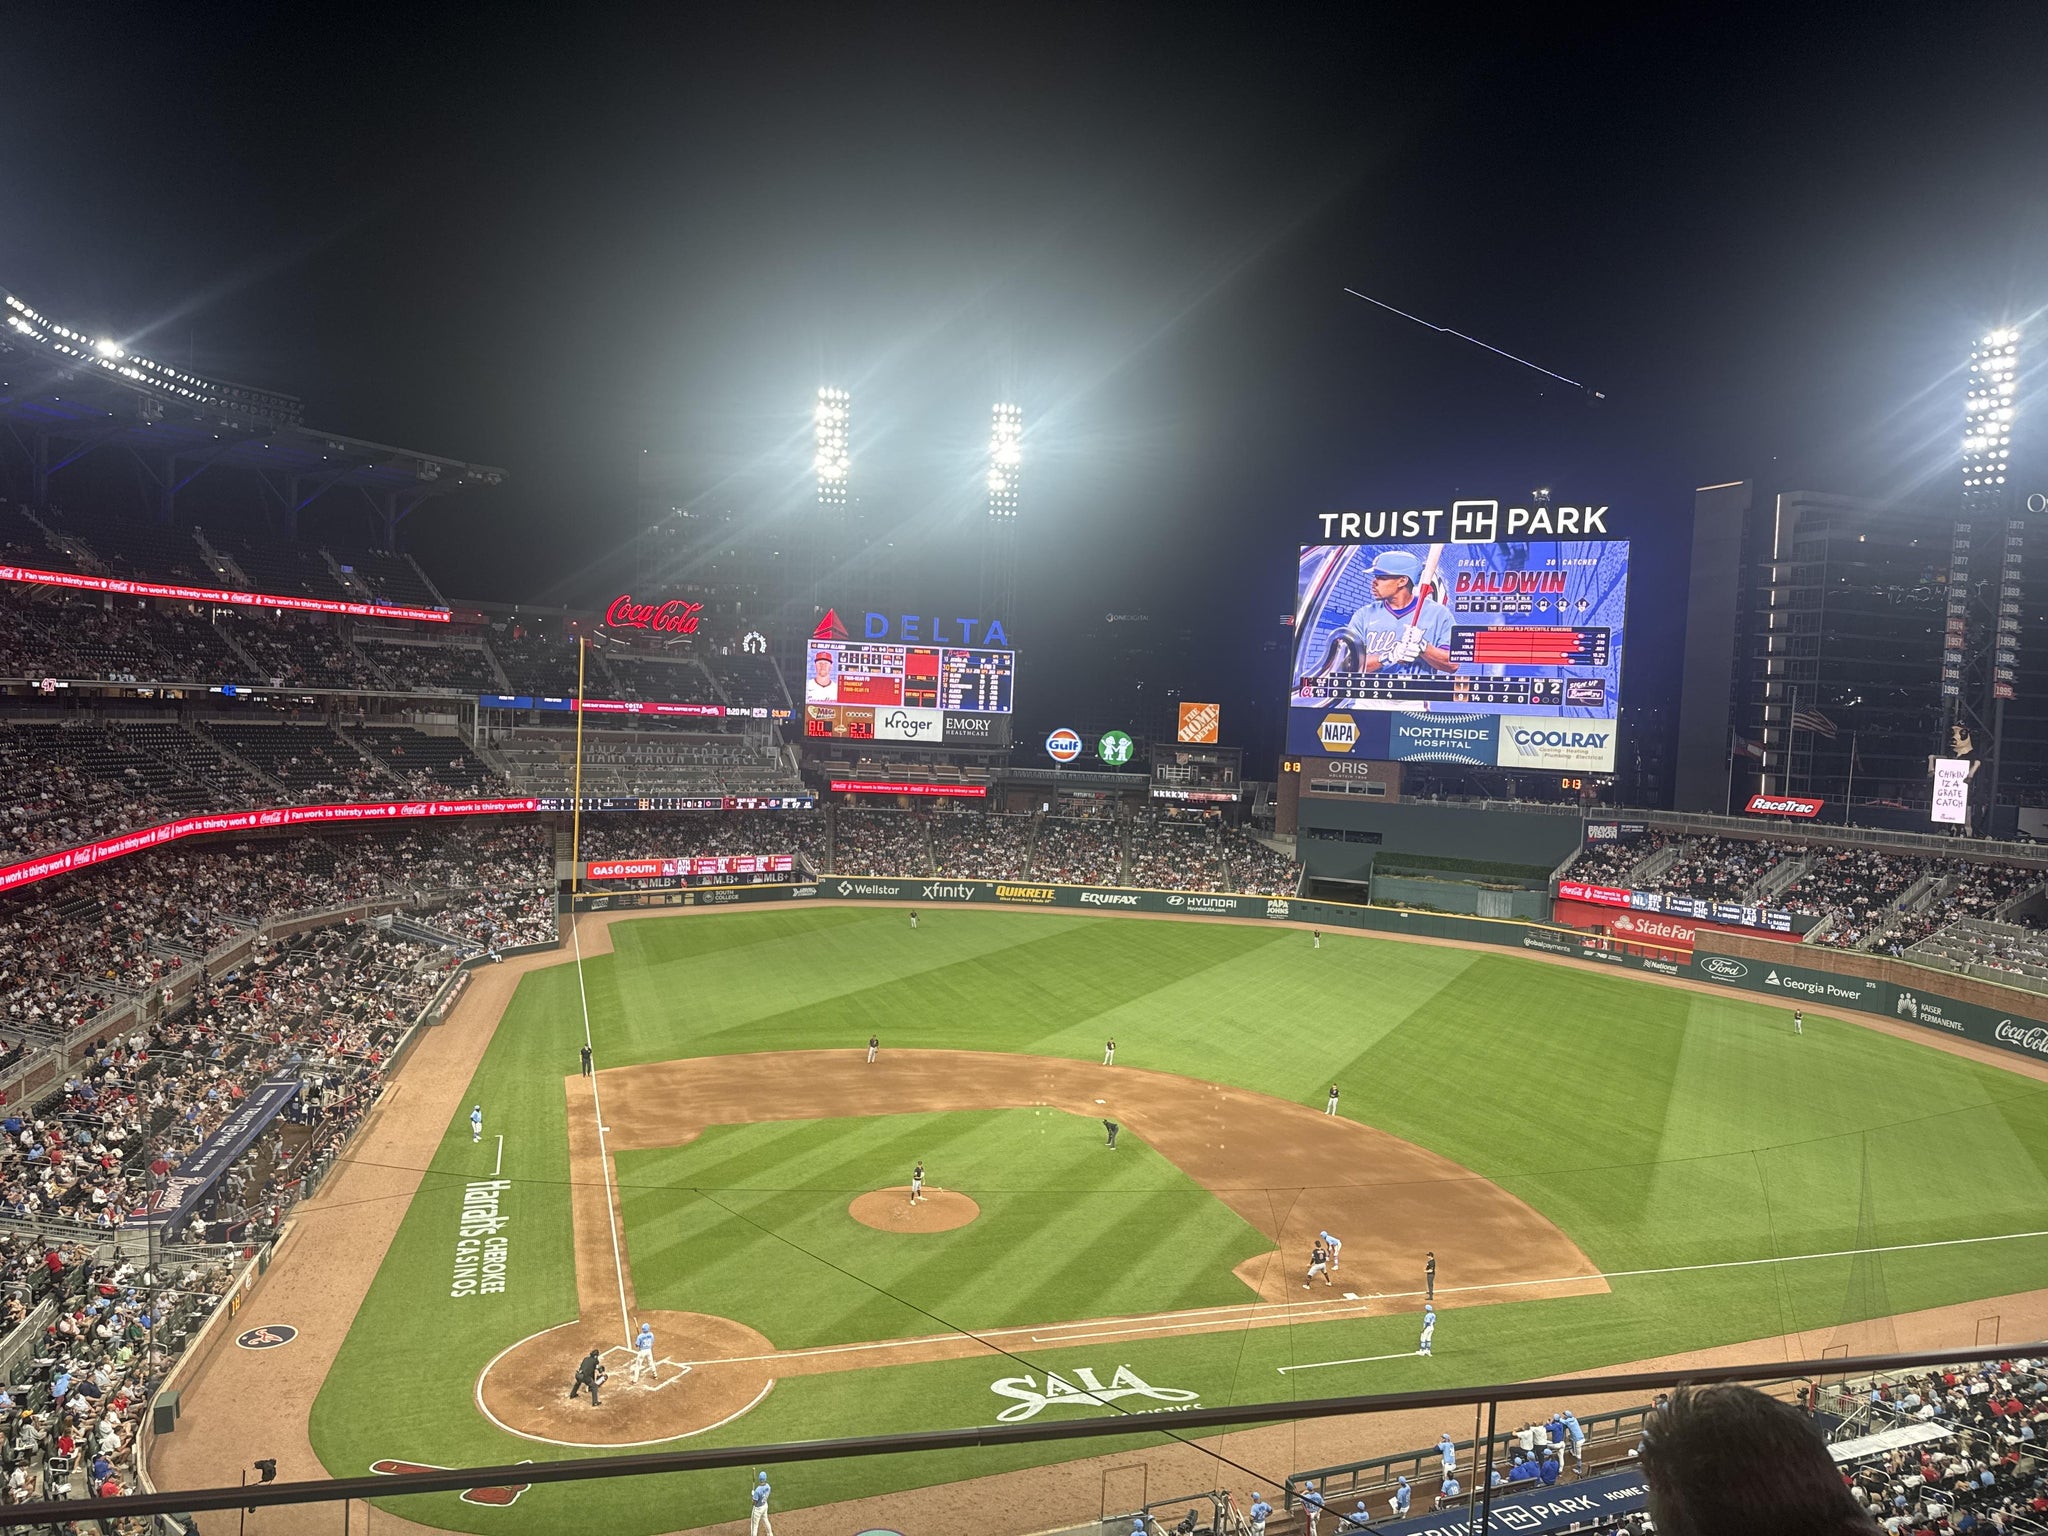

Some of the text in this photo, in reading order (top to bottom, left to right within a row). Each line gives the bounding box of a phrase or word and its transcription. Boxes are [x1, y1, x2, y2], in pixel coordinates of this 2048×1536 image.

[1319, 506, 1609, 539] TRUIST PARK
[1458, 559, 1486, 567] DRAKE
[1456, 570, 1568, 594] BALDWIN
[148, 587, 168, 595] work
[176, 589, 201, 598] thirsty
[606, 594, 704, 634] Coca-Cola
[1950, 604, 1966, 614] 1897
[864, 612, 1008, 646] DELTA
[1948, 638, 1962, 646] 1957
[1999, 654, 2014, 662] 1982
[1946, 670, 1960, 678] 1991
[1998, 670, 2013, 680] 1992
[41, 678, 57, 692] 47
[222, 684, 237, 696] 42
[1534, 683, 1544, 694] 0
[1550, 684, 1560, 694] 2
[1944, 686, 1959, 695] 1993
[1996, 686, 2012, 696] 1995
[740, 708, 750, 716] PM
[1184, 707, 1200, 723] THE
[808, 720, 824, 732] 80
[885, 711, 932, 738] Kroger
[946, 718, 992, 731] EMORY
[1180, 704, 1218, 741] HOME
[1194, 718, 1218, 742] DEPOT
[1324, 724, 1353, 742] NAPA
[1399, 726, 1489, 740] NORTHSIDE
[1048, 740, 1079, 750] Gulf
[1414, 740, 1472, 749] HOSPITAL
[1514, 730, 1610, 748] COOLRAY
[583, 745, 758, 765] HANK AARON TERRACE
[1284, 761, 1301, 773] 0:13
[1329, 762, 1368, 774] ORIS
[1938, 770, 1966, 778] CHIKIN
[1562, 778, 1582, 790] 0:13
[1942, 779, 1950, 788] IZ
[1938, 788, 1962, 798] GRATE
[401, 804, 427, 815] Coca-Cola
[482, 802, 506, 812] thirsty
[1752, 798, 1814, 814] RaceTrac
[1936, 798, 1964, 808] CATCH
[260, 812, 282, 825] Coca-Cola
[292, 812, 304, 820] Fan
[304, 810, 324, 818] work
[334, 808, 364, 818] thirsty
[364, 807, 386, 815] work
[1588, 826, 1618, 834] BRAVES
[593, 864, 657, 876] GAS SOUTH
[662, 864, 675, 872] AL
[649, 876, 676, 888] MLB+
[713, 875, 740, 885] MB+
[764, 872, 789, 882] MLB+
[854, 884, 900, 895] Wellstar
[922, 882, 976, 900] xfinity
[996, 886, 1056, 899] QUIKRETE
[1560, 886, 1584, 896] Coca-Cola
[1080, 892, 1138, 906] EQUIFAX
[1187, 897, 1238, 908] HYUNDAI
[1268, 900, 1289, 908] PAPA
[1592, 894, 1608, 902] thirsty
[1632, 896, 1646, 906] NL
[1694, 906, 1709, 915] CHC
[1742, 914, 1757, 922] LAD
[1524, 937, 1571, 953] globalpayments
[1651, 961, 1678, 972] National
[1708, 959, 1740, 976] Ford
[1783, 977, 1861, 1000] Georgia Power
[1921, 1004, 1942, 1016] KAISER
[1920, 1013, 1962, 1031] PERMANENTE
[460, 1180, 512, 1237] Harrah's
[450, 1239, 481, 1298] CASINOS
[480, 1236, 508, 1295] CHEROKEE
[990, 1364, 1200, 1422] SAIA
[1530, 1494, 1600, 1518] PARK
[1604, 1486, 1644, 1502] HOME
